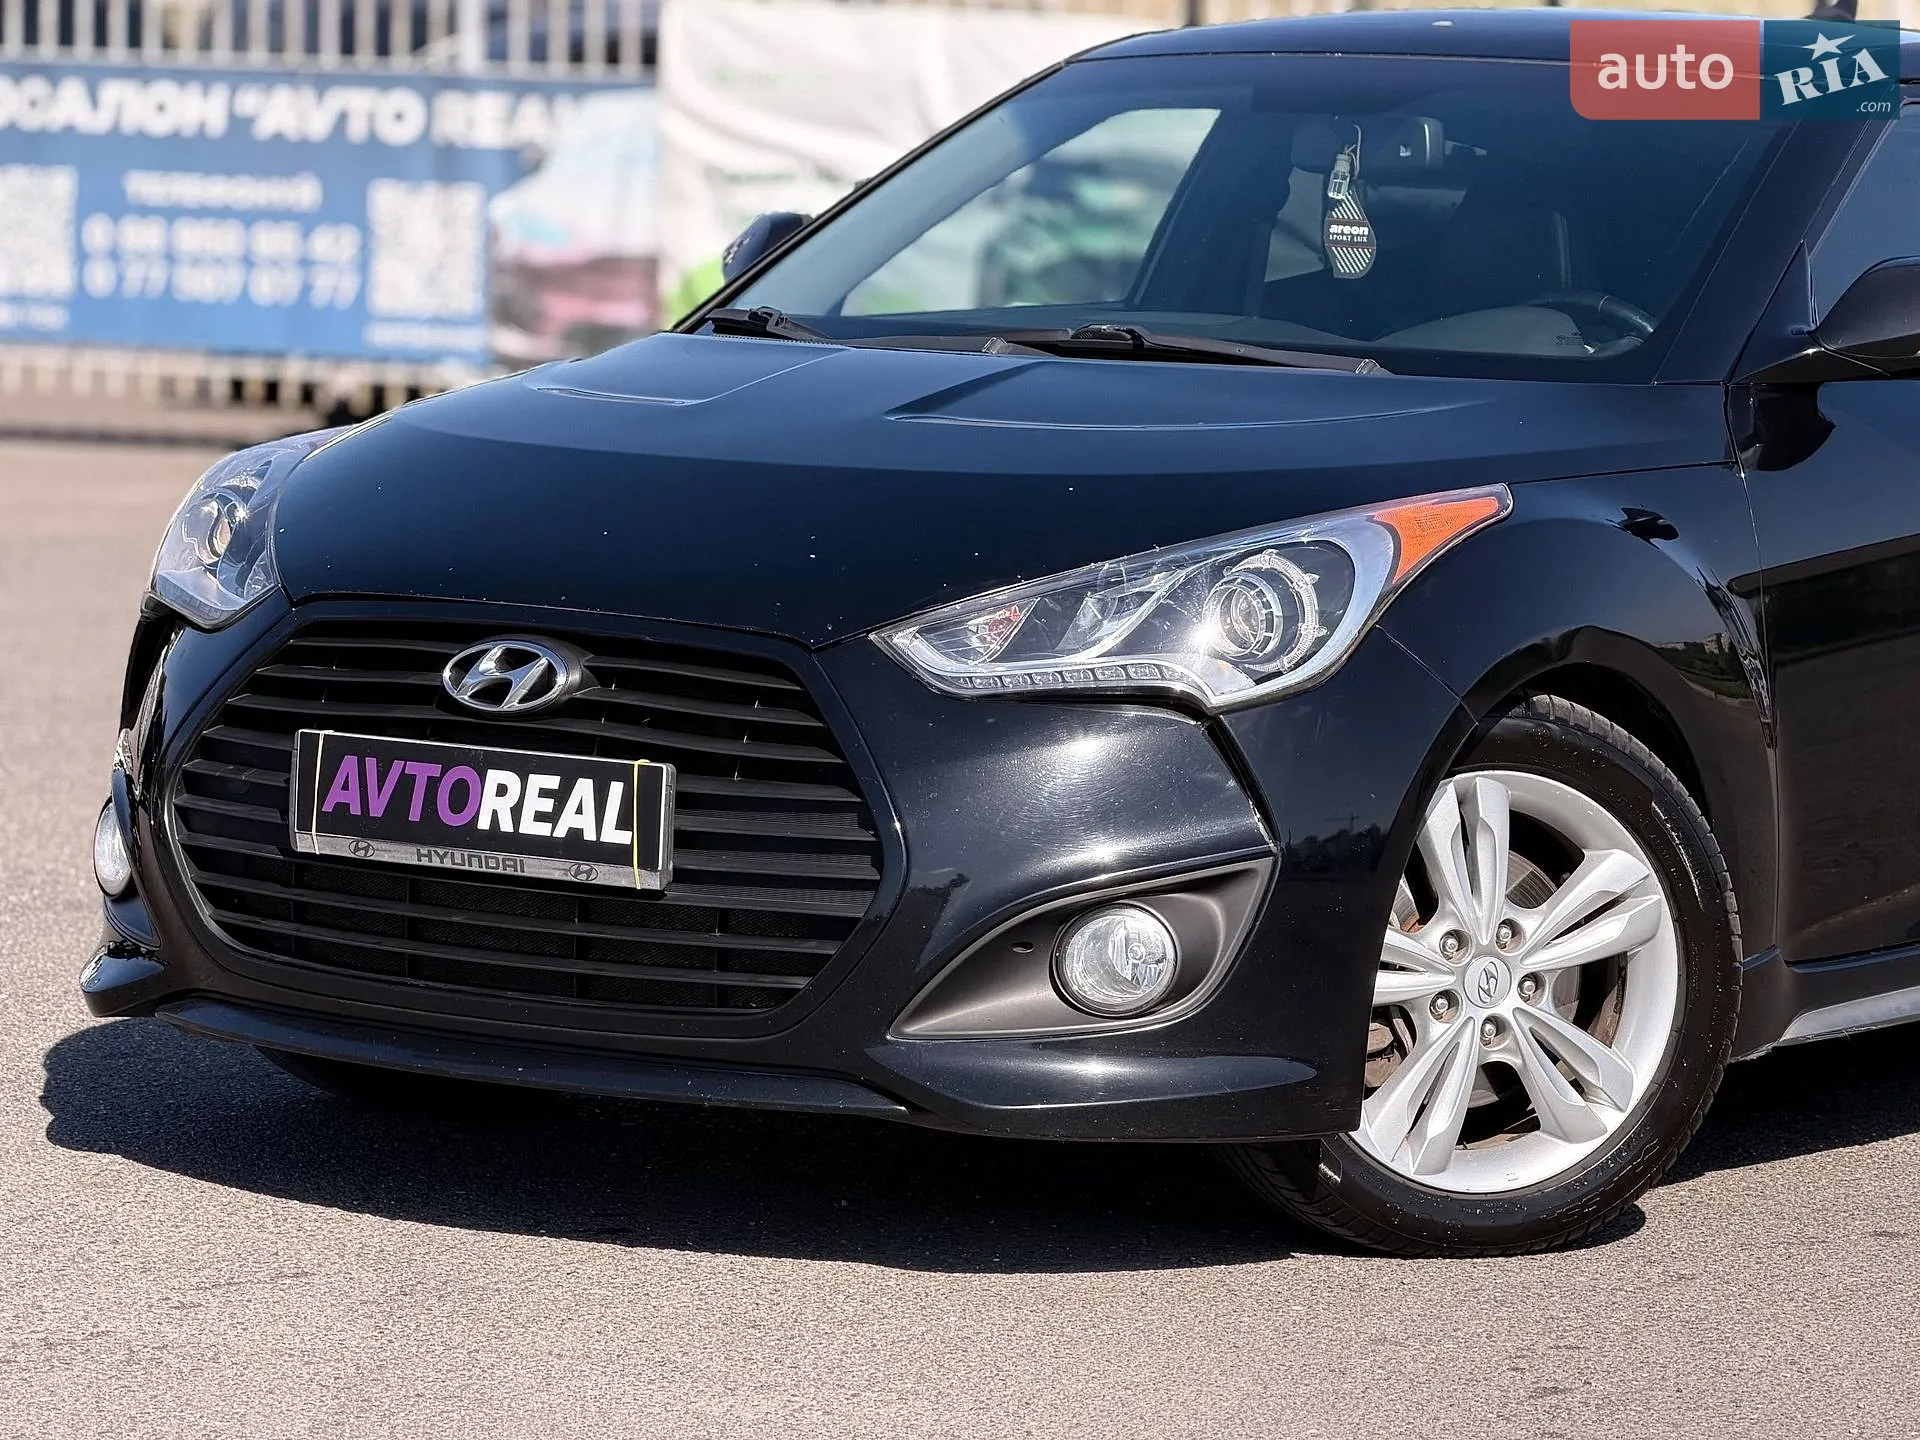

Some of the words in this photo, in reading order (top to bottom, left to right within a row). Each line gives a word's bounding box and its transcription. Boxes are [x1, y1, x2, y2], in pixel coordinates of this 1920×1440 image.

[1329, 224, 1369, 236] areon
[1329, 234, 1352, 242] SPORT
[321, 755, 633, 845] AVTOREAL
[416, 848, 525, 873] HYUNDAI
